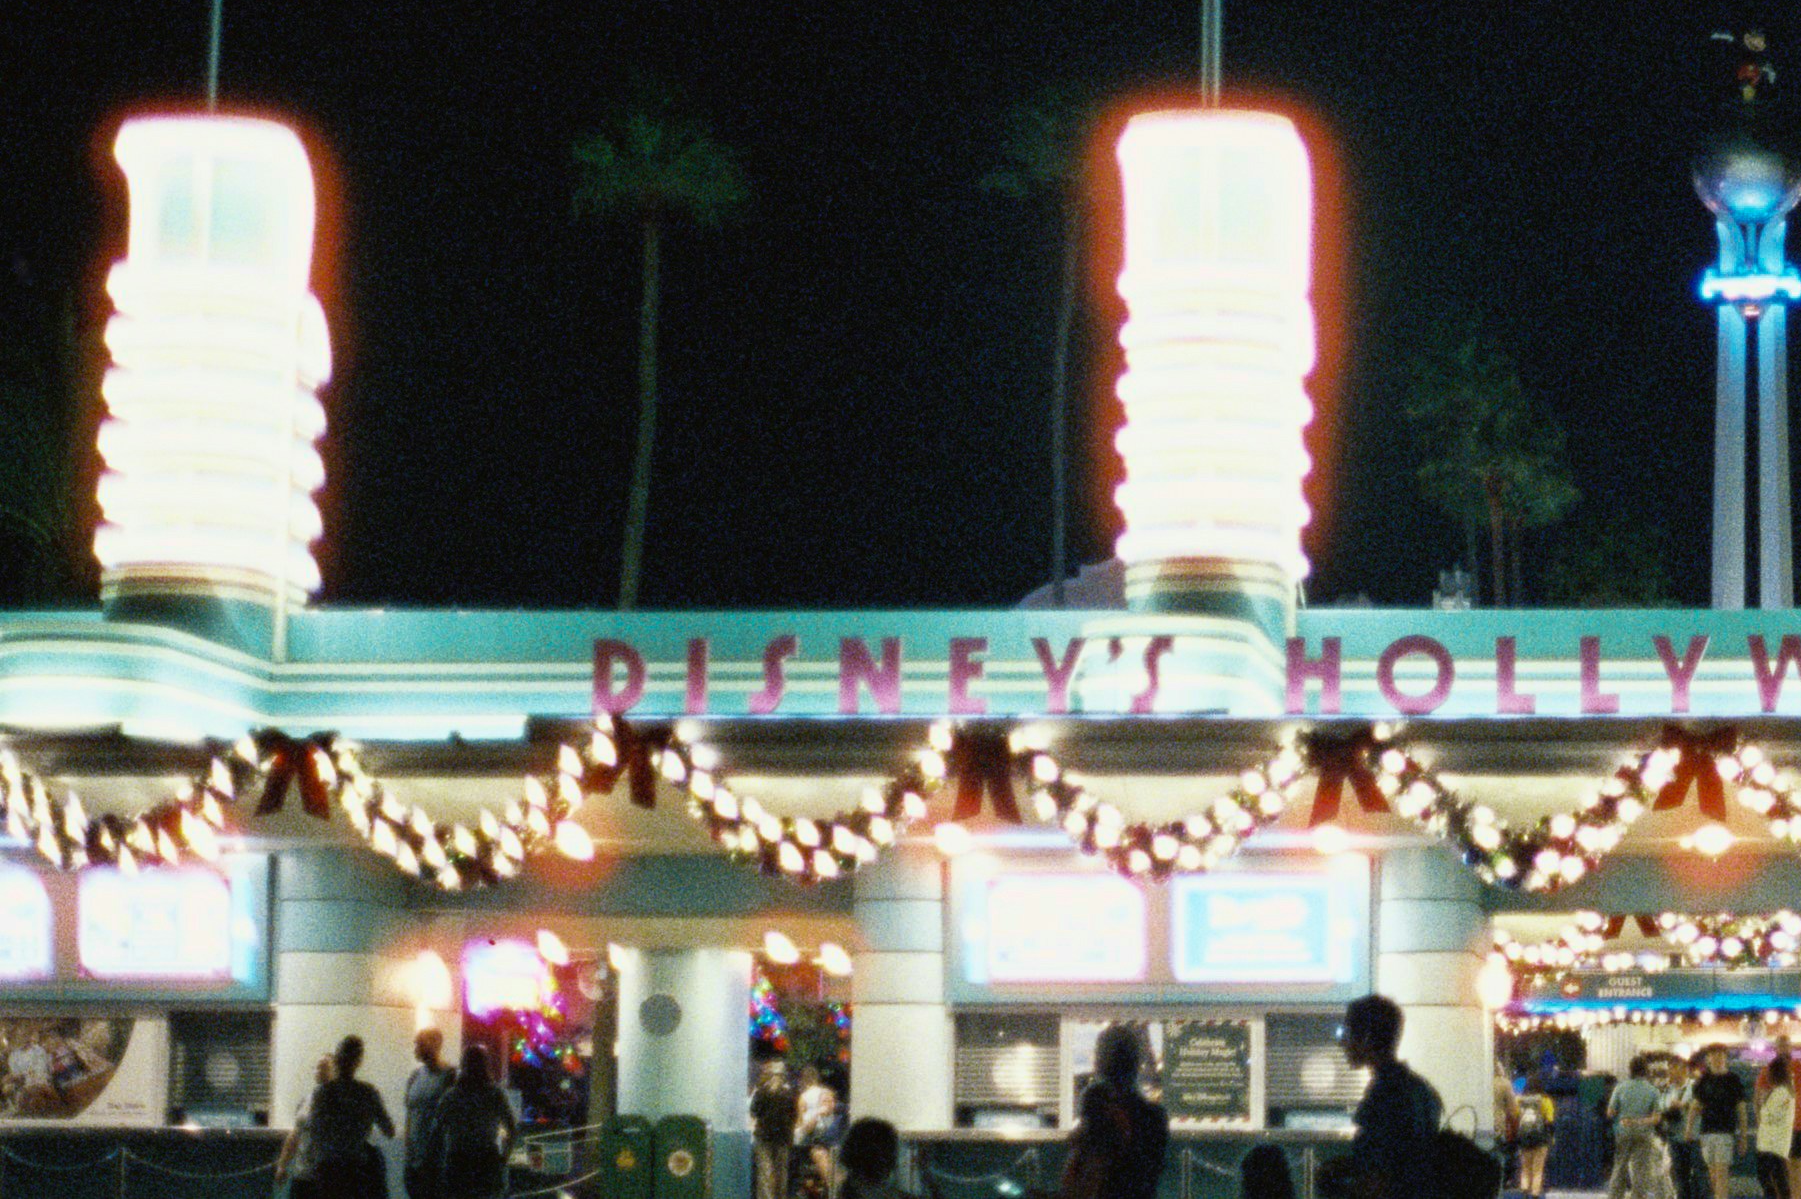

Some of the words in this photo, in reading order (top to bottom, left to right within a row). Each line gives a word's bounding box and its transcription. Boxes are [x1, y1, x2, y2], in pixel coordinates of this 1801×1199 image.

[591, 634, 1175, 714] DISNEY'S
[1608, 977, 1642, 987] GUEST
[1598, 987, 1653, 998] ENTRANCE
